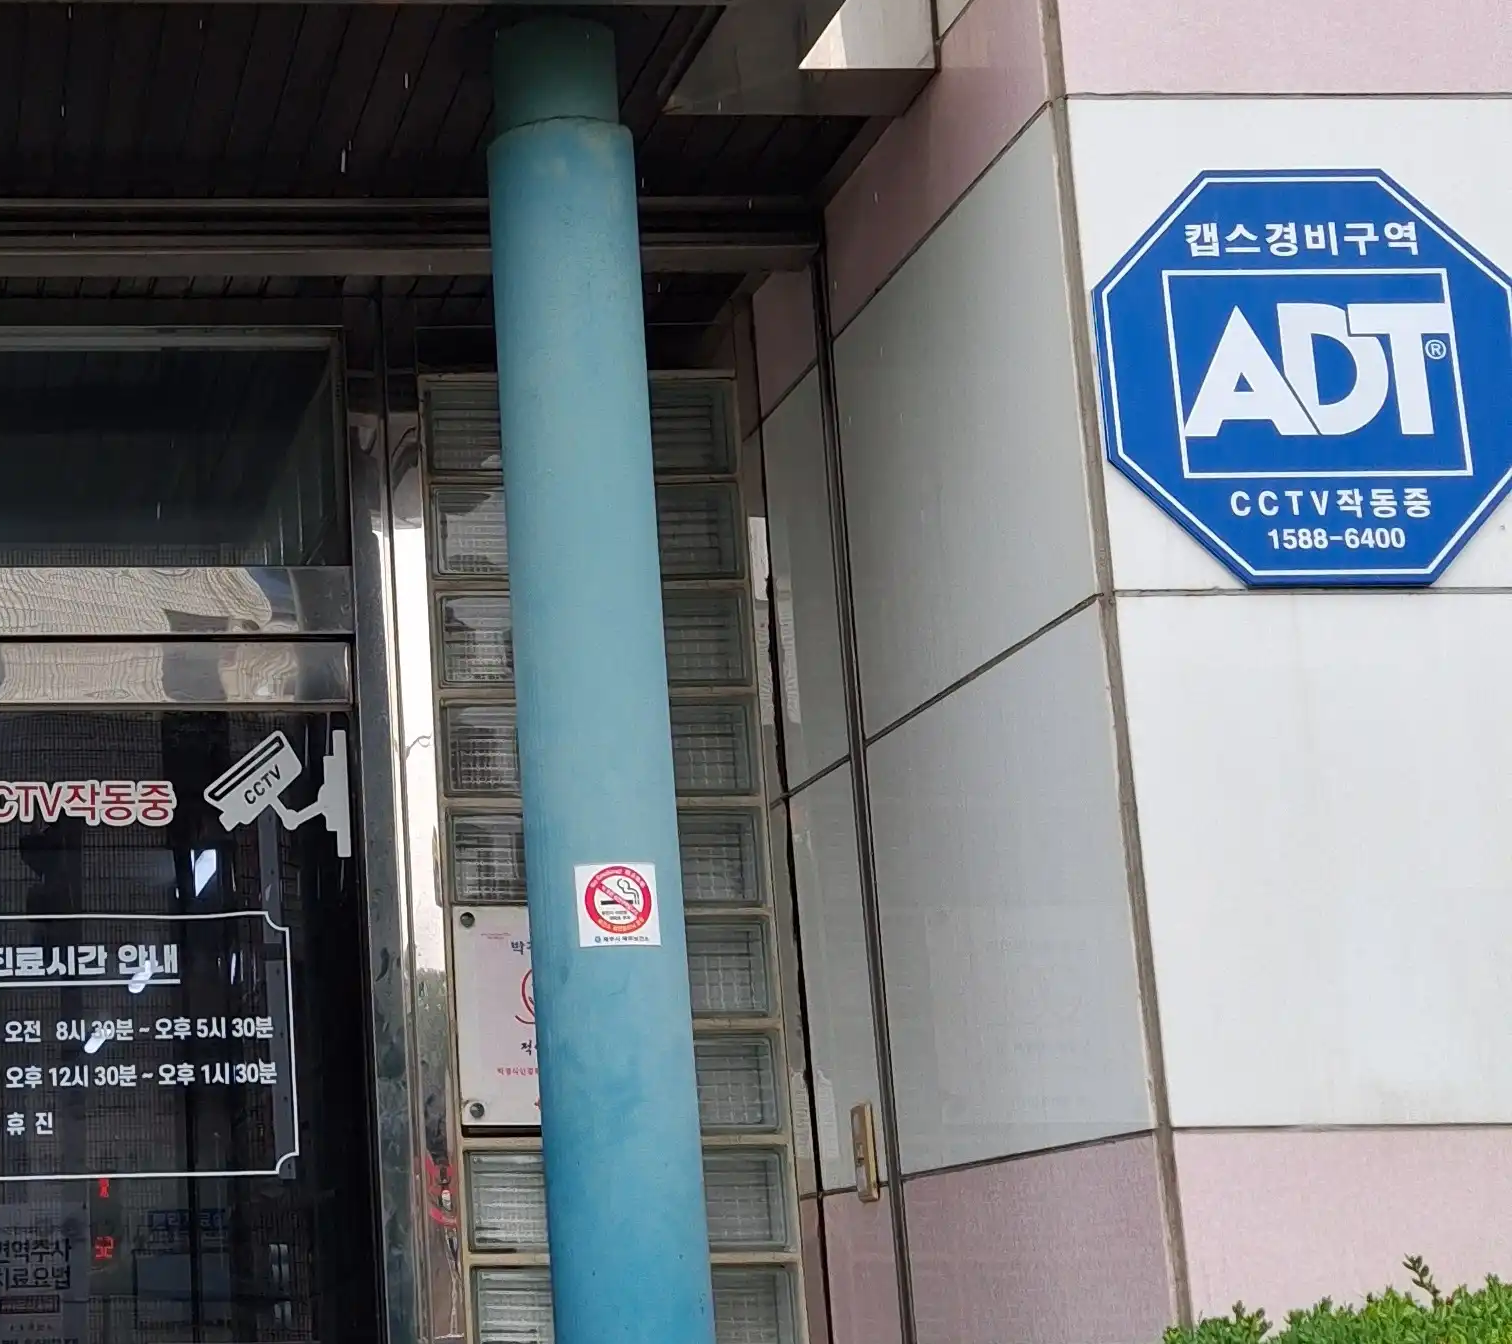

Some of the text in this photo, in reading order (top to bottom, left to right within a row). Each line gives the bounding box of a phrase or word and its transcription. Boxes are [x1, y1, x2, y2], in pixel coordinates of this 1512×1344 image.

[1184, 221, 1420, 258] 캡스경비구역
[1230, 488, 1433, 519] CCTV작동중
[1267, 526, 1407, 551] 1588-6400
[243, 764, 283, 806] CCTV
[117, 943, 179, 975] 안내
[5, 1020, 41, 1043] 오전
[55, 1019, 85, 1041] 8시
[91, 1018, 134, 1042] 30분
[155, 1018, 192, 1041] 오후
[196, 1016, 226, 1039] 5시
[231, 1015, 274, 1039] 30분
[5, 1066, 42, 1089] 오후
[49, 1065, 88, 1088] 12시
[94, 1064, 138, 1087] 30분
[158, 1063, 195, 1086] 오후
[200, 1062, 230, 1085] 1시
[234, 1061, 277, 1084] 30분
